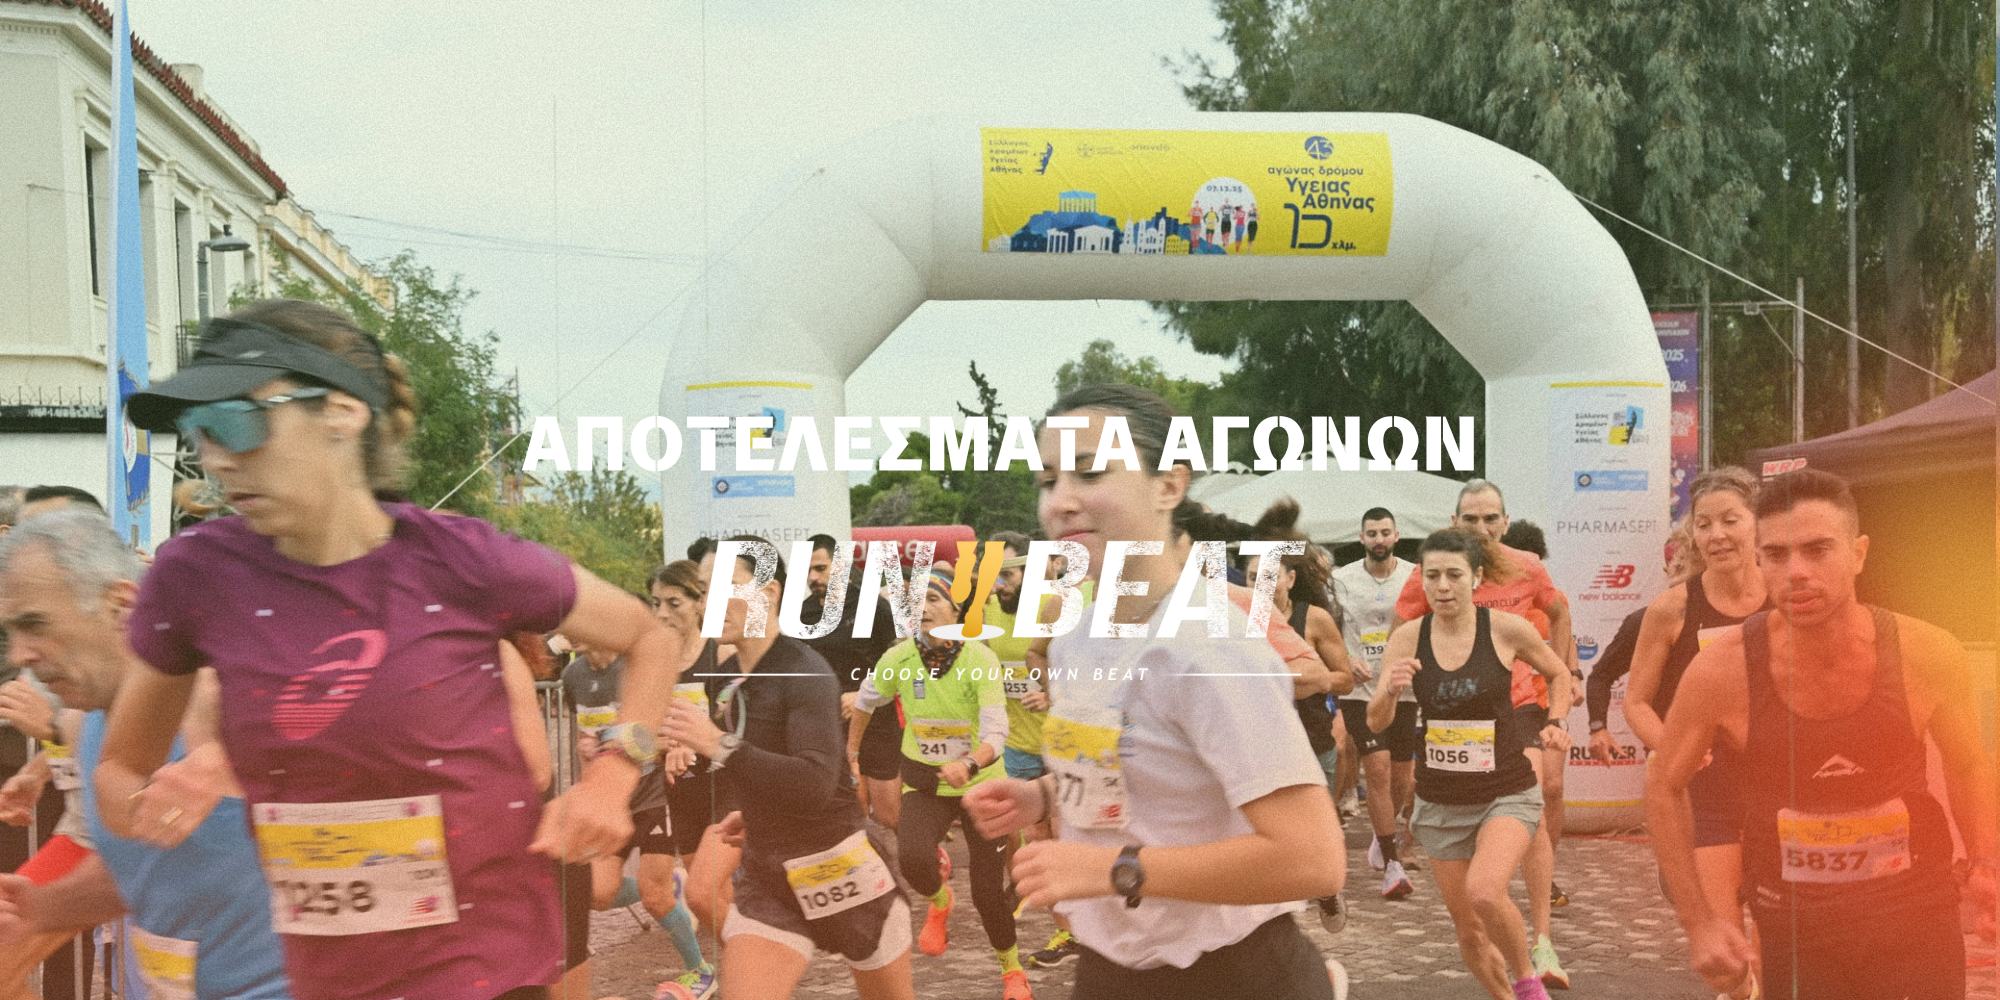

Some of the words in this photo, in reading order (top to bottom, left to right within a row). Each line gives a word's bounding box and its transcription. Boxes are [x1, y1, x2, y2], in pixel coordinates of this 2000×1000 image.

[1268, 166, 1315, 176] αγώνας
[1319, 165, 1364, 176] δρόμου
[1206, 184, 1243, 193] 07.12.25
[1302, 193, 1375, 213] Αθηνας
[1557, 521, 1657, 533] PHARMASEPT
[1602, 592, 1641, 601] balance
[1428, 748, 1469, 764] 1056
[1785, 850, 1868, 871] 5837
[802, 881, 861, 910] 1082
